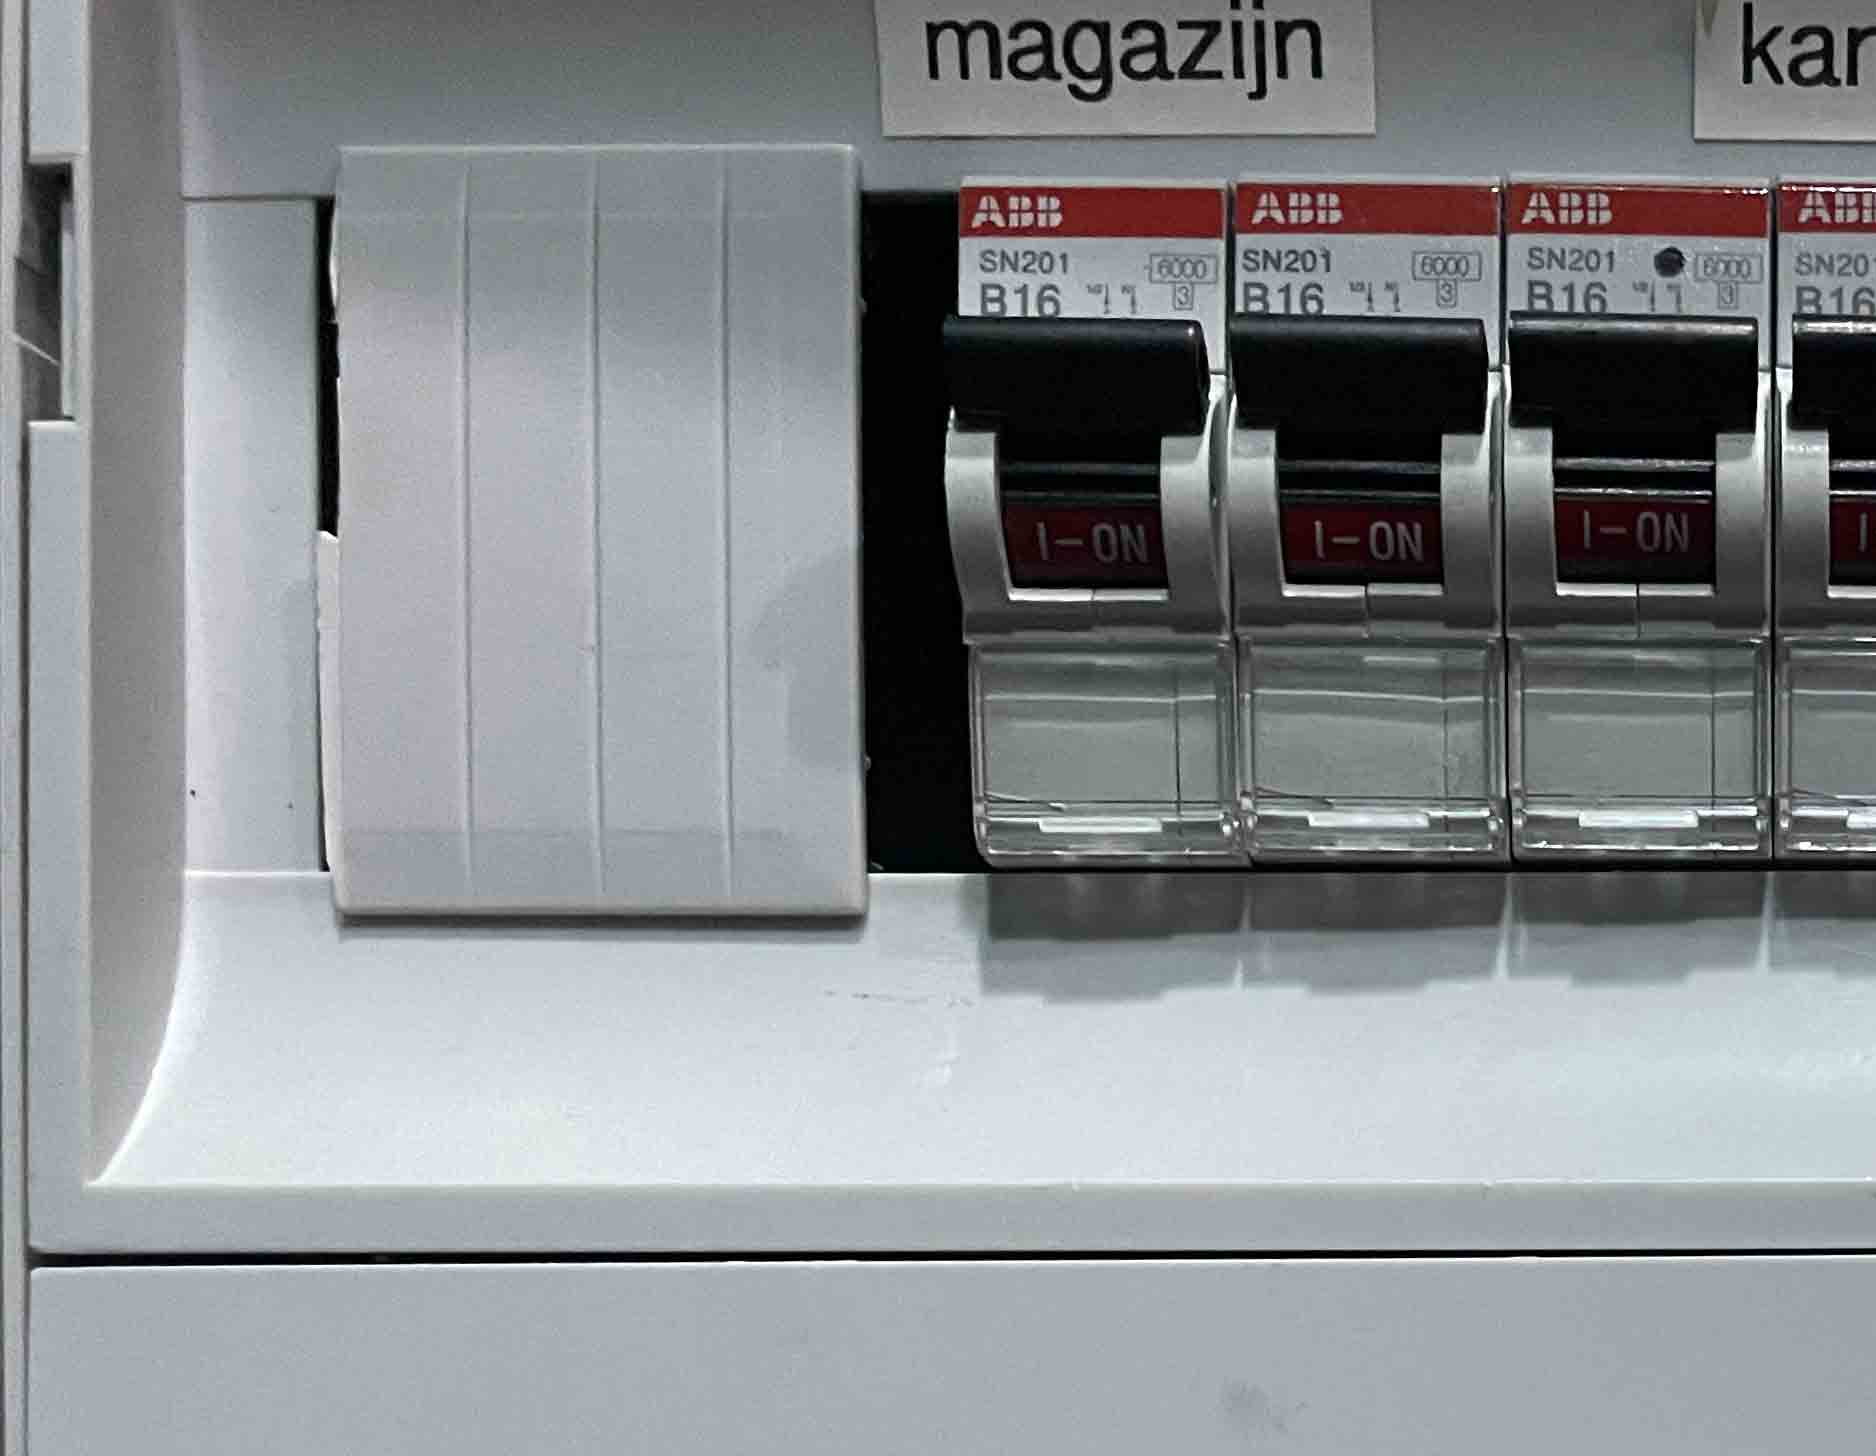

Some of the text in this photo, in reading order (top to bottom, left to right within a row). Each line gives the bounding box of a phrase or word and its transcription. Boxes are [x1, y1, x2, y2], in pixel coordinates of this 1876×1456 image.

[926, 0, 1324, 103] magazijn
[971, 195, 1063, 228] ABB
[1251, 192, 1343, 224] ABB
[1521, 192, 1613, 224] ABB
[979, 250, 1068, 274] SN201
[1158, 258, 1206, 279] 6000
[1242, 249, 1330, 273] SN201
[1421, 256, 1469, 276] 6000
[1527, 247, 1615, 273] SN201
[980, 283, 1061, 317] B16
[1243, 282, 1323, 315] B16
[1527, 280, 1607, 312] B16
[1795, 286, 1875, 316] B16
